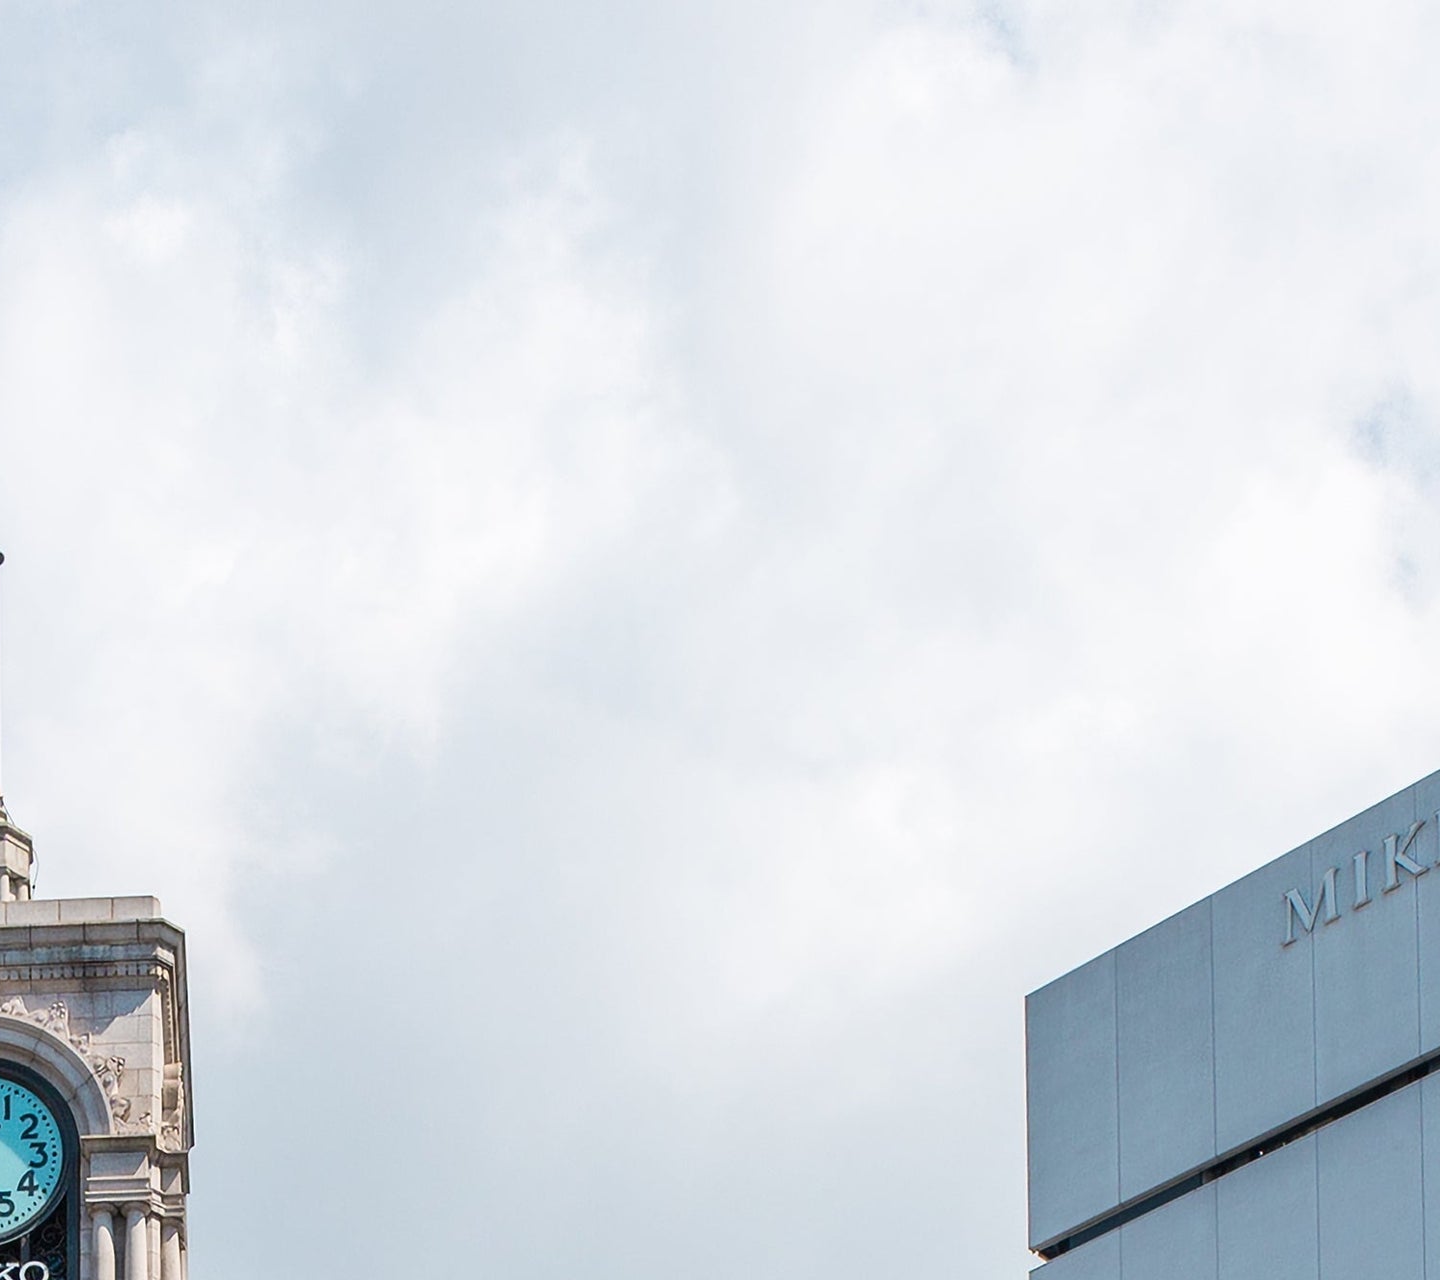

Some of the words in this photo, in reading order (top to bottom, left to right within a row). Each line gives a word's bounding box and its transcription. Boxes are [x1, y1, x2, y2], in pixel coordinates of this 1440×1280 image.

[4, 1095, 11, 1120] 1
[20, 1114, 39, 1139] 2
[30, 1143, 48, 1168] 3
[17, 1171, 39, 1197] 4
